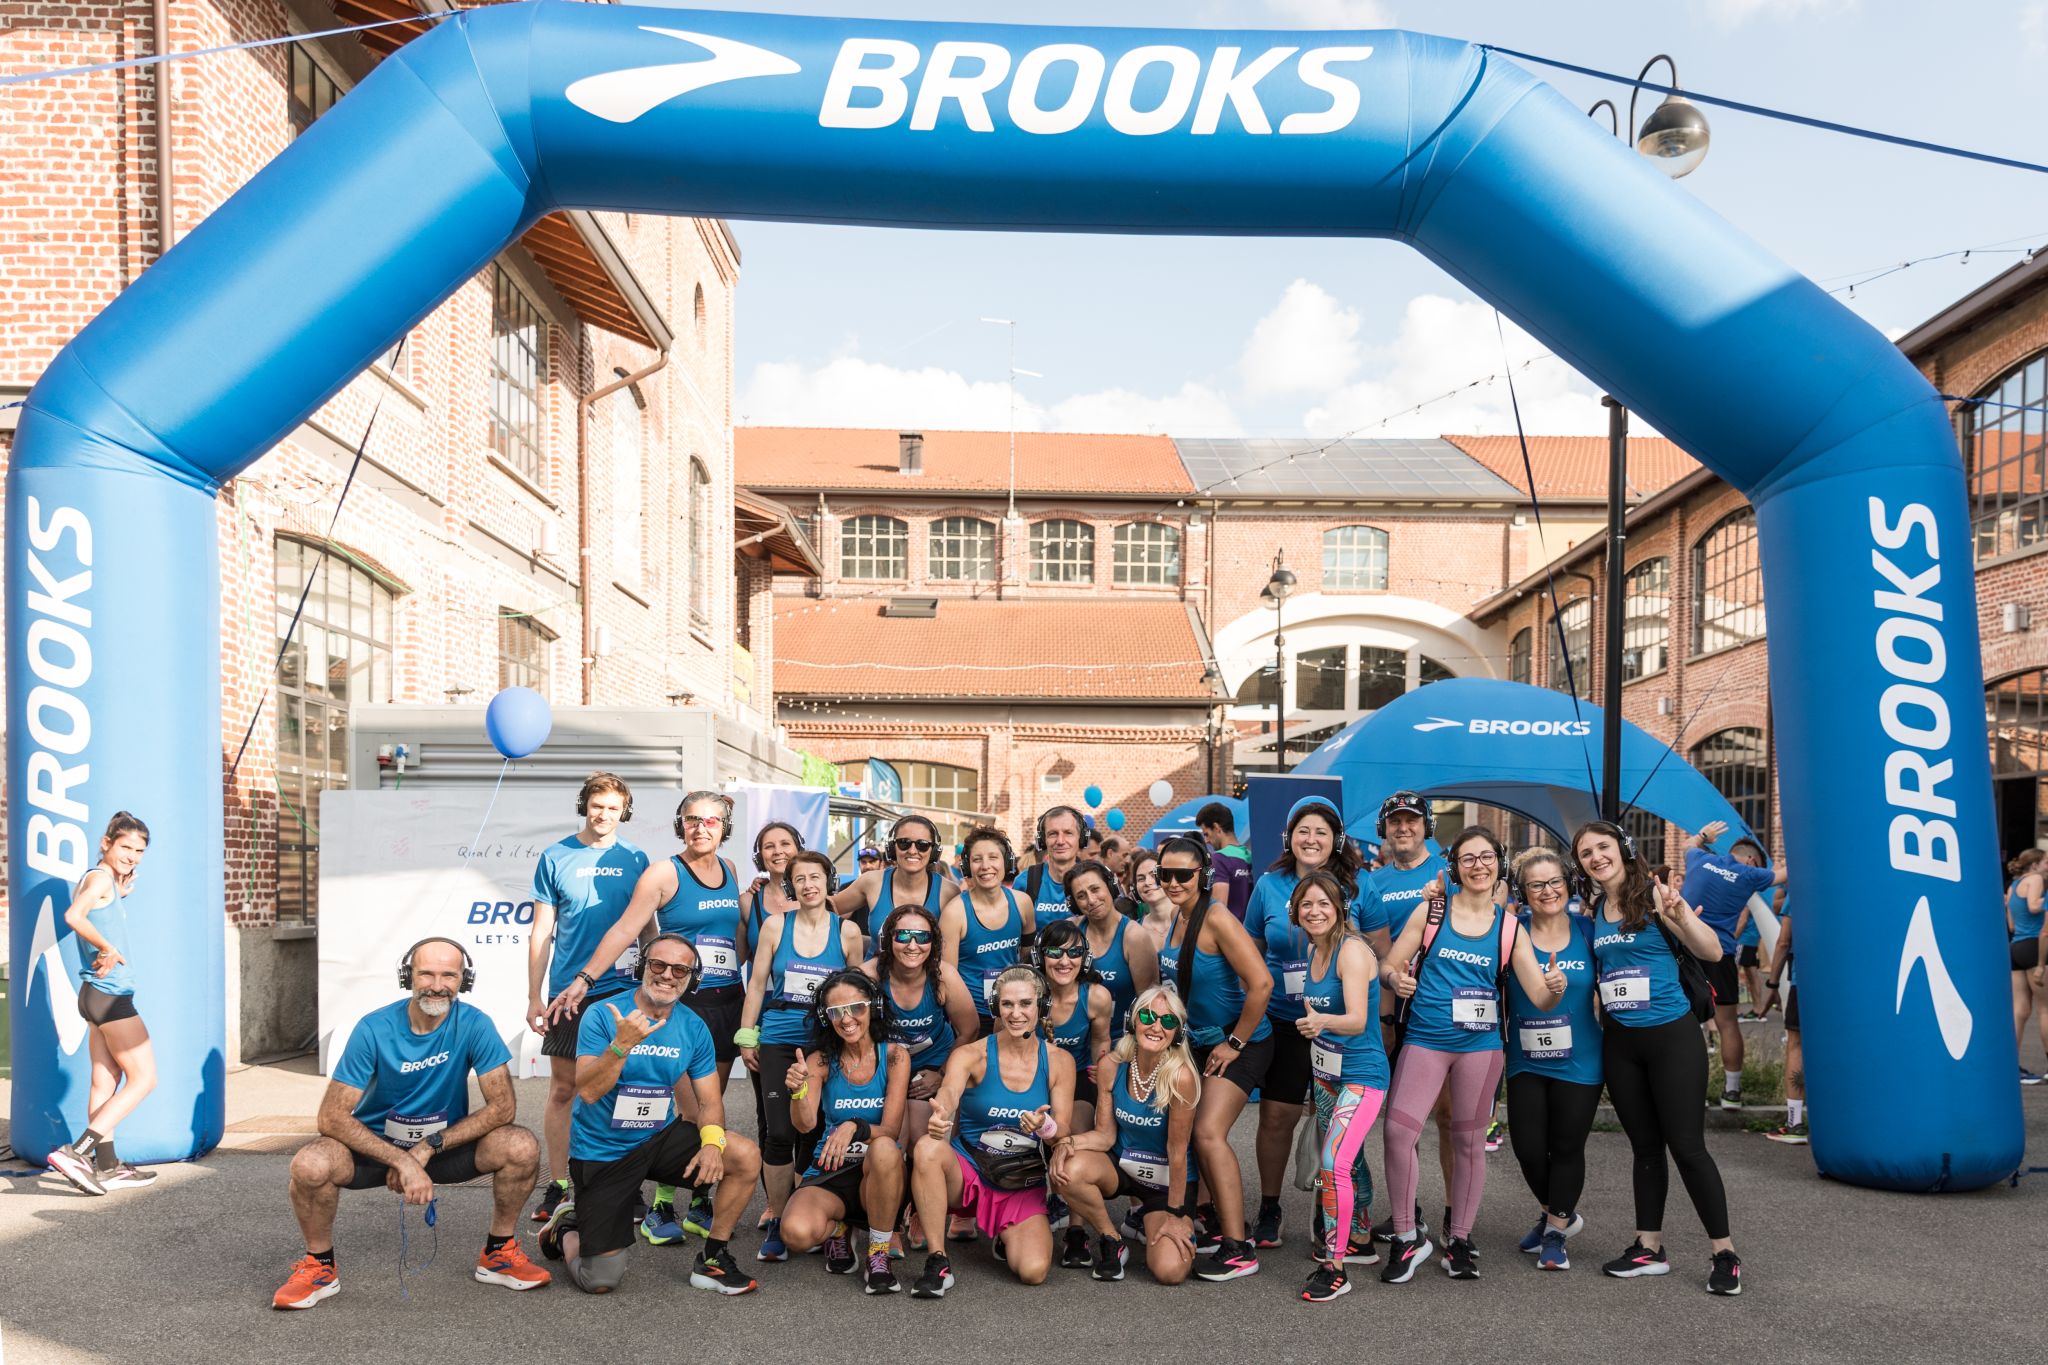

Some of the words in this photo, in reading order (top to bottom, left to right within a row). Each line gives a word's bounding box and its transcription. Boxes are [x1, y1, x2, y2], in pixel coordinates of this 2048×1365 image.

[819, 37, 1374, 136] BROOKS
[26, 495, 94, 884] BROOKS
[1868, 496, 1962, 882] BROOKS
[1468, 719, 1592, 736] BROOKS
[457, 844, 489, 859] Qual
[525, 845, 541, 858] tu
[575, 866, 624, 878] BROOKS
[1702, 862, 1740, 880] BROOKS
[698, 898, 739, 910] BROOKS
[1036, 903, 1070, 913] BROO
[467, 901, 535, 925] BRO
[475, 934, 520, 944] LET'S
[1593, 933, 1637, 949] BROOKS
[976, 937, 1020, 954] BROOKS
[714, 954, 726, 964] 19
[1160, 955, 1178, 970] ROOK
[1438, 947, 1492, 967] BROOKS
[703, 967, 733, 977] BROOKS
[1538, 960, 1585, 972] ROKS
[806, 982, 815, 992] 6
[1613, 986, 1627, 997] 18
[791, 994, 812, 1003] BRO
[1306, 996, 1331, 1007] OOKS
[1474, 1007, 1486, 1018] 17
[1607, 1001, 1639, 1012] BROOKS
[892, 1014, 933, 1028] ROOKS
[1537, 1036, 1552, 1047] 16
[629, 1044, 680, 1058] BROOKS
[1530, 1050, 1565, 1058] BROOKS
[1315, 1055, 1324, 1067] 21
[1312, 1069, 1331, 1081] OOKS
[834, 1097, 885, 1109] BROOKS
[636, 1106, 650, 1116] 15
[988, 1106, 1025, 1119] BROO
[1115, 1107, 1162, 1127] BROOKS
[620, 1120, 656, 1129] BROOKS
[407, 1131, 423, 1139] 13
[393, 1139, 414, 1148] BRO
[846, 1143, 863, 1154] 22
[1003, 1138, 1013, 1148] 9
[1136, 1169, 1154, 1179] 25
